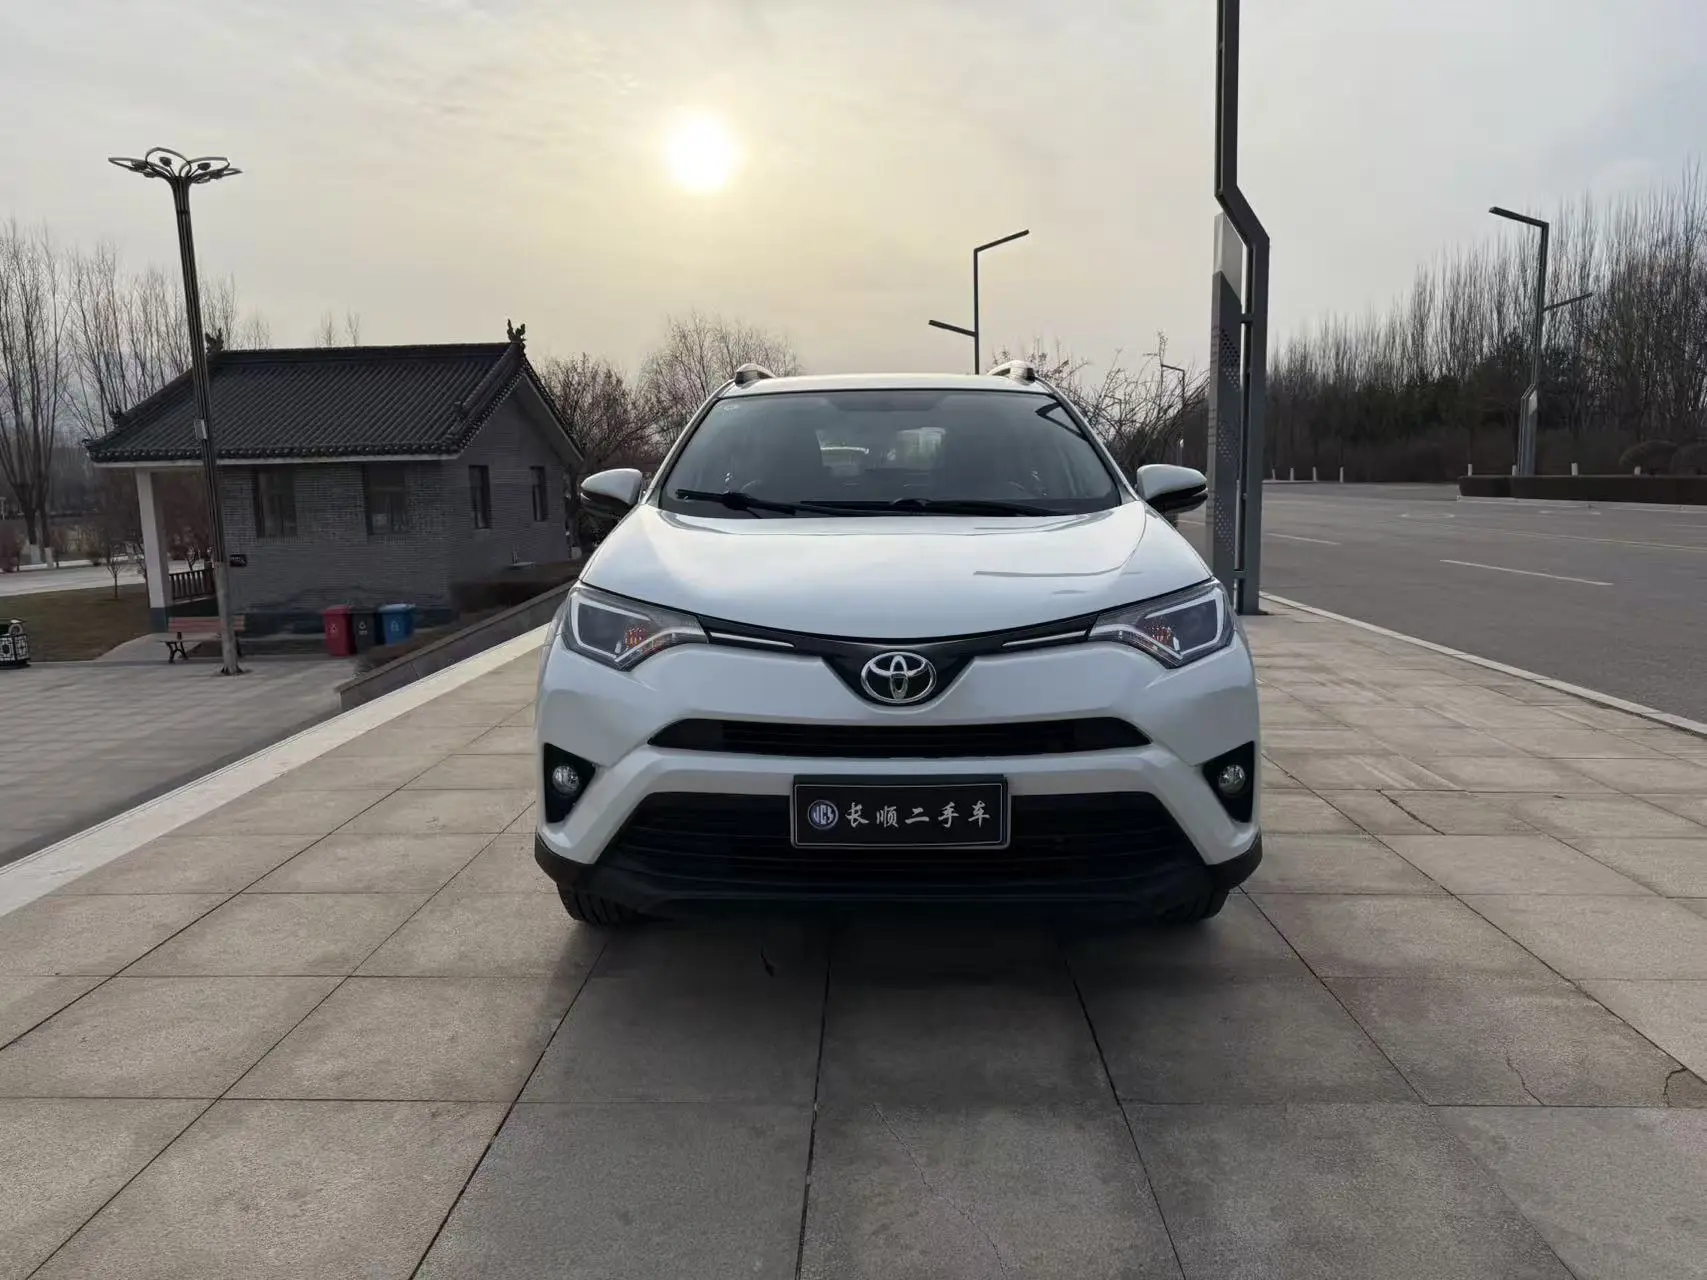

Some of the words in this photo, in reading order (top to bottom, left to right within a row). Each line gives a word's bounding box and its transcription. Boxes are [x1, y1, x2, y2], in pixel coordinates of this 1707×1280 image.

[845, 801, 990, 828] 长顺二手车
